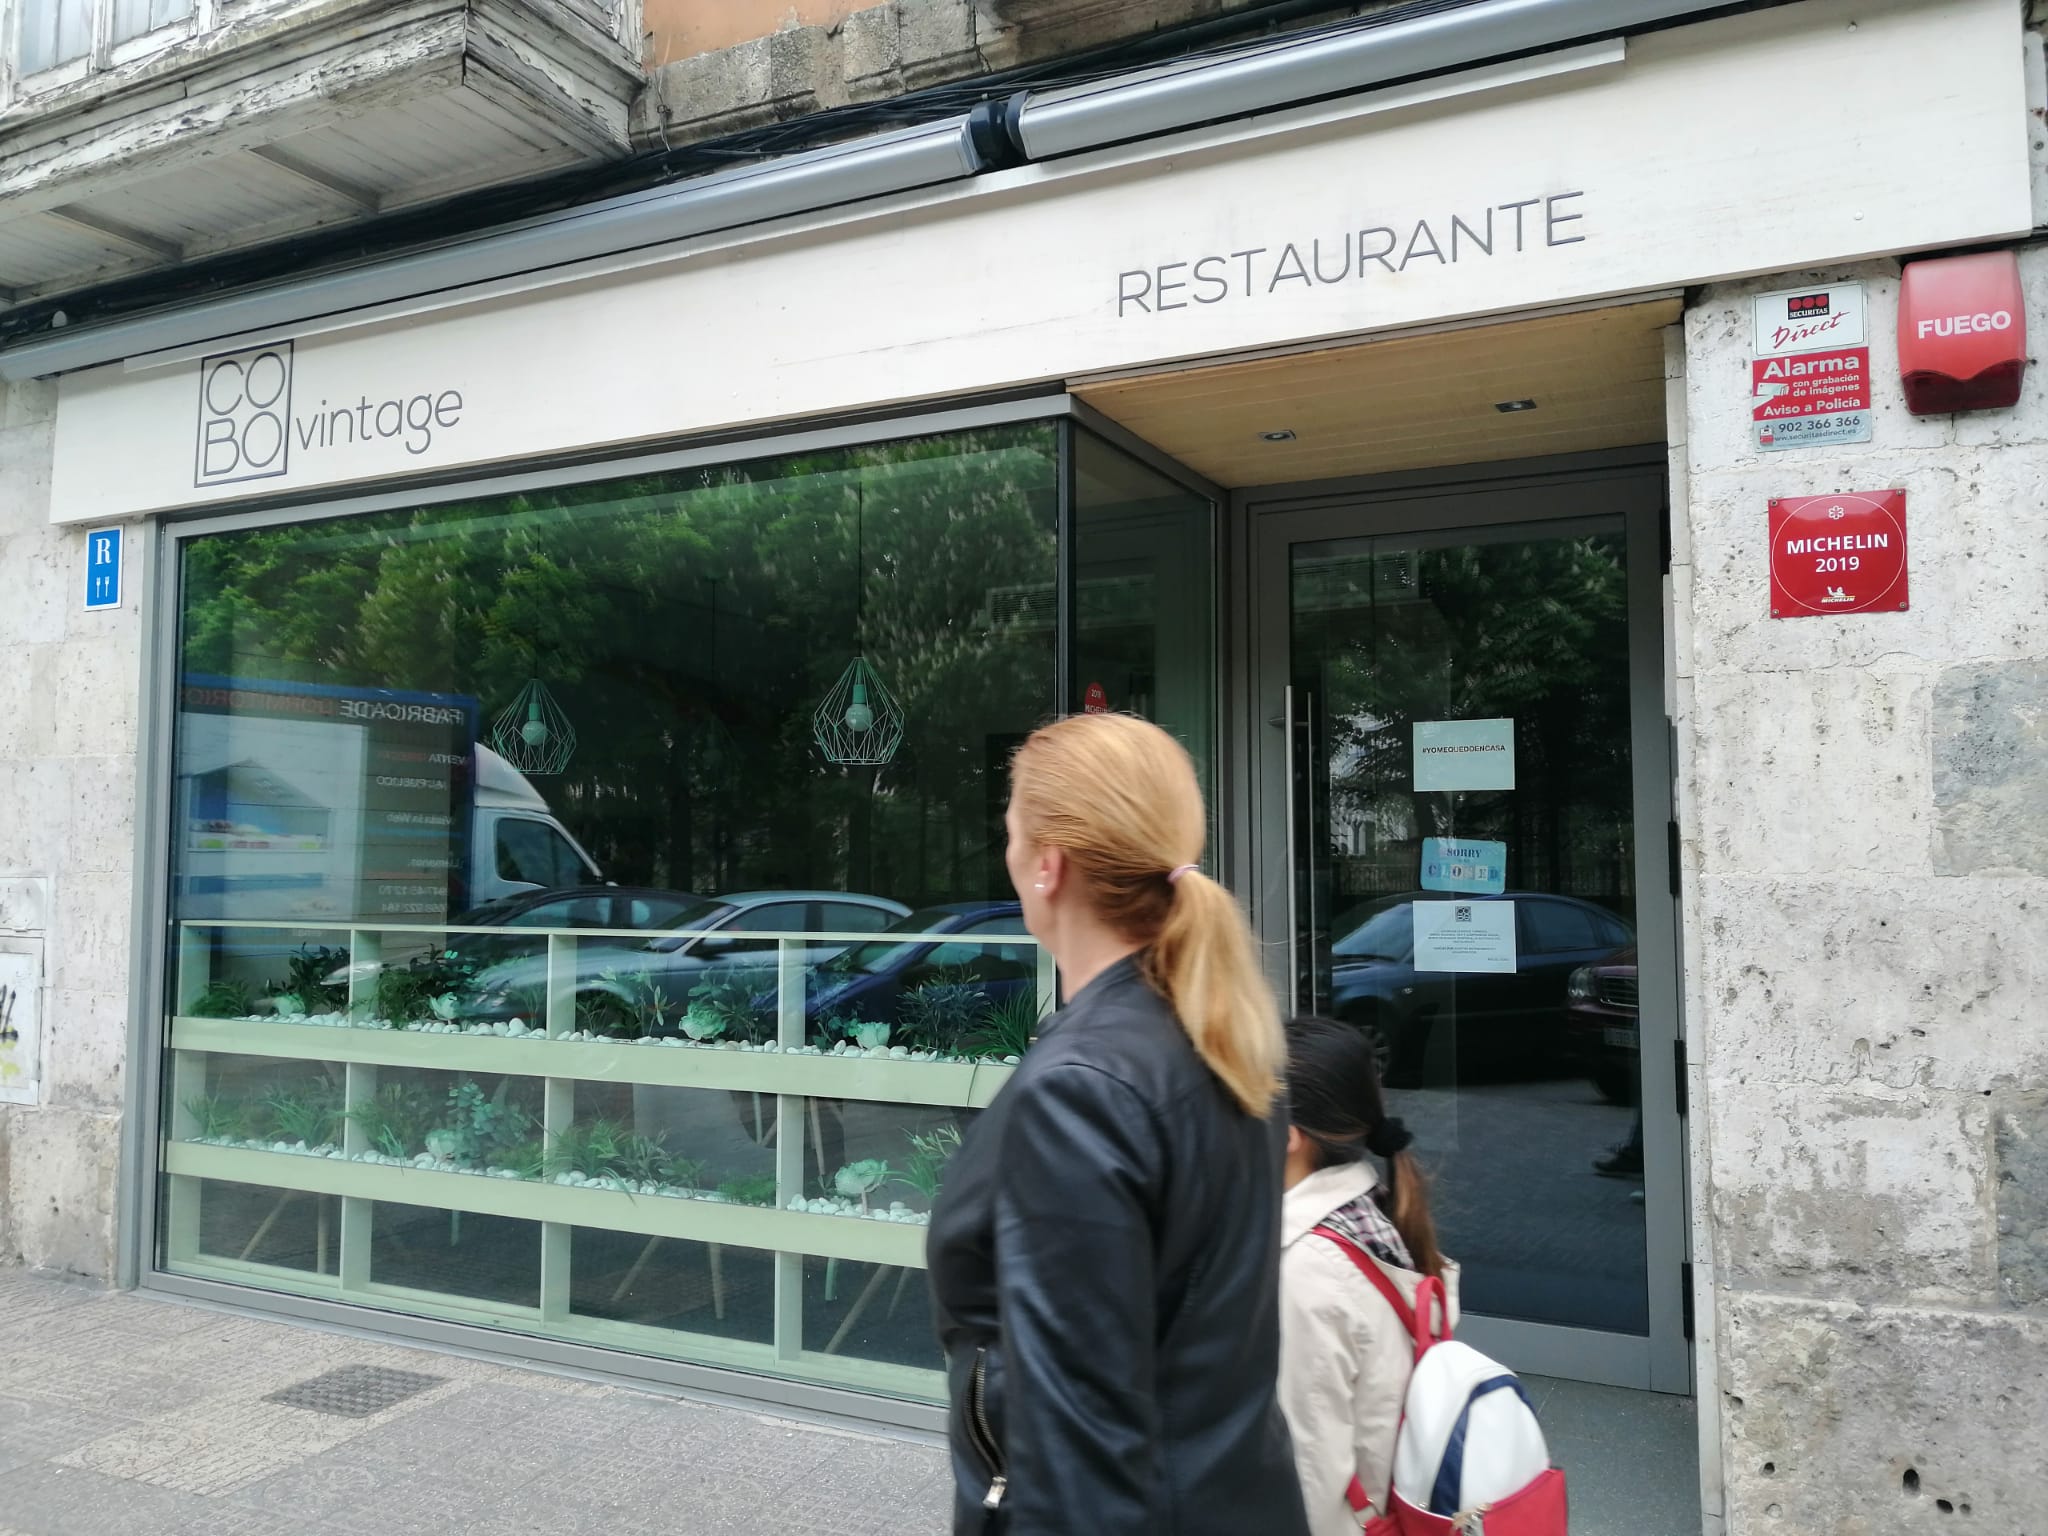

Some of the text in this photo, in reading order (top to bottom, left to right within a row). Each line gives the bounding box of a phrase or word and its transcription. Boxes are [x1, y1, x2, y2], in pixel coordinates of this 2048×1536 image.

[1119, 190, 1586, 317] RESTAURANTE
[1790, 307, 1828, 318] SECURITAS
[1771, 311, 1850, 349] Direct
[1917, 310, 2012, 339] FUEGO
[1763, 356, 1859, 379] Alarma
[1793, 374, 1859, 388] con grabación
[1793, 383, 1860, 397] de imágenes
[1763, 405, 1800, 417] Aviso
[1817, 397, 1861, 411] Policía
[296, 389, 463, 455] vintage
[1779, 416, 1861, 433] 902 366 366
[95, 537, 111, 565] R
[1787, 533, 1889, 555] MICHELIN
[1815, 556, 1860, 574] 2019
[1446, 848, 1482, 858] SORRY
